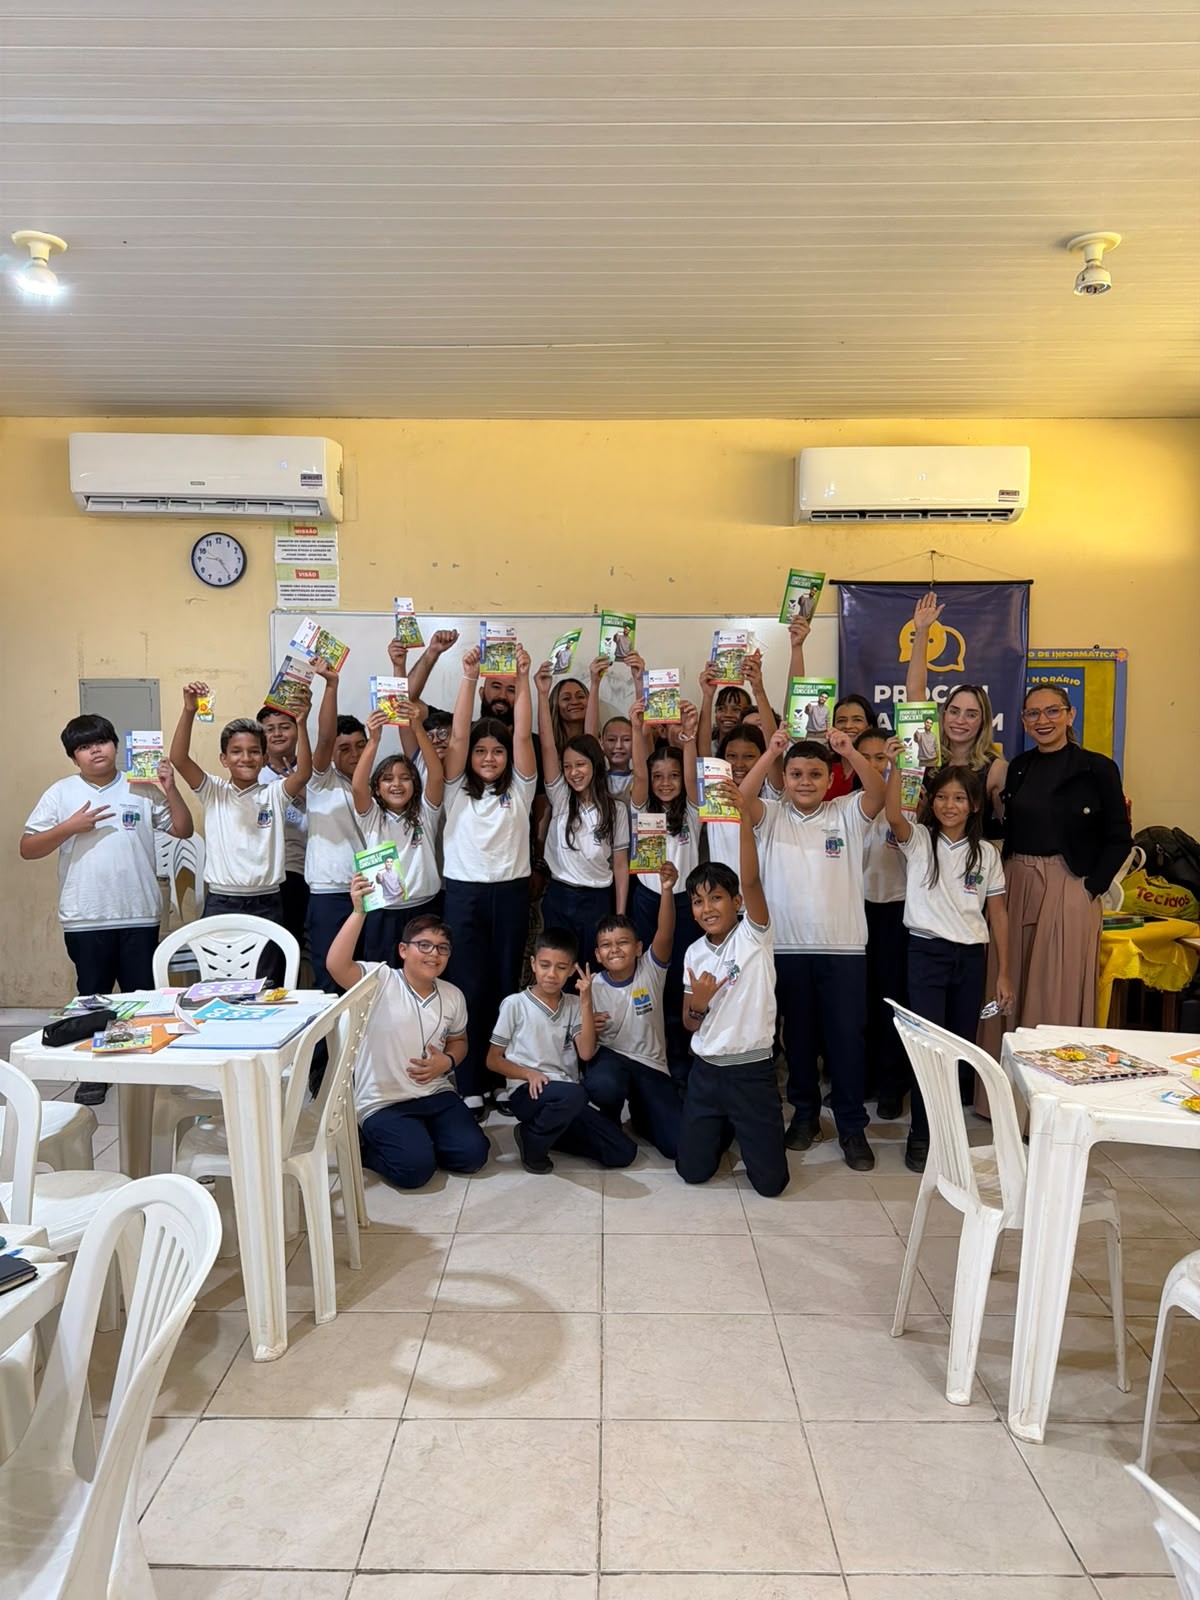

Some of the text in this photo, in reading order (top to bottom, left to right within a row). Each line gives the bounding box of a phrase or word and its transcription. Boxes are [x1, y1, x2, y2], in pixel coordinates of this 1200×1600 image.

[206, 540, 212, 548] 11
[215, 537, 222, 545] 12
[233, 546, 238, 554] 2
[1031, 674, 1081, 686] HORÁRIO
